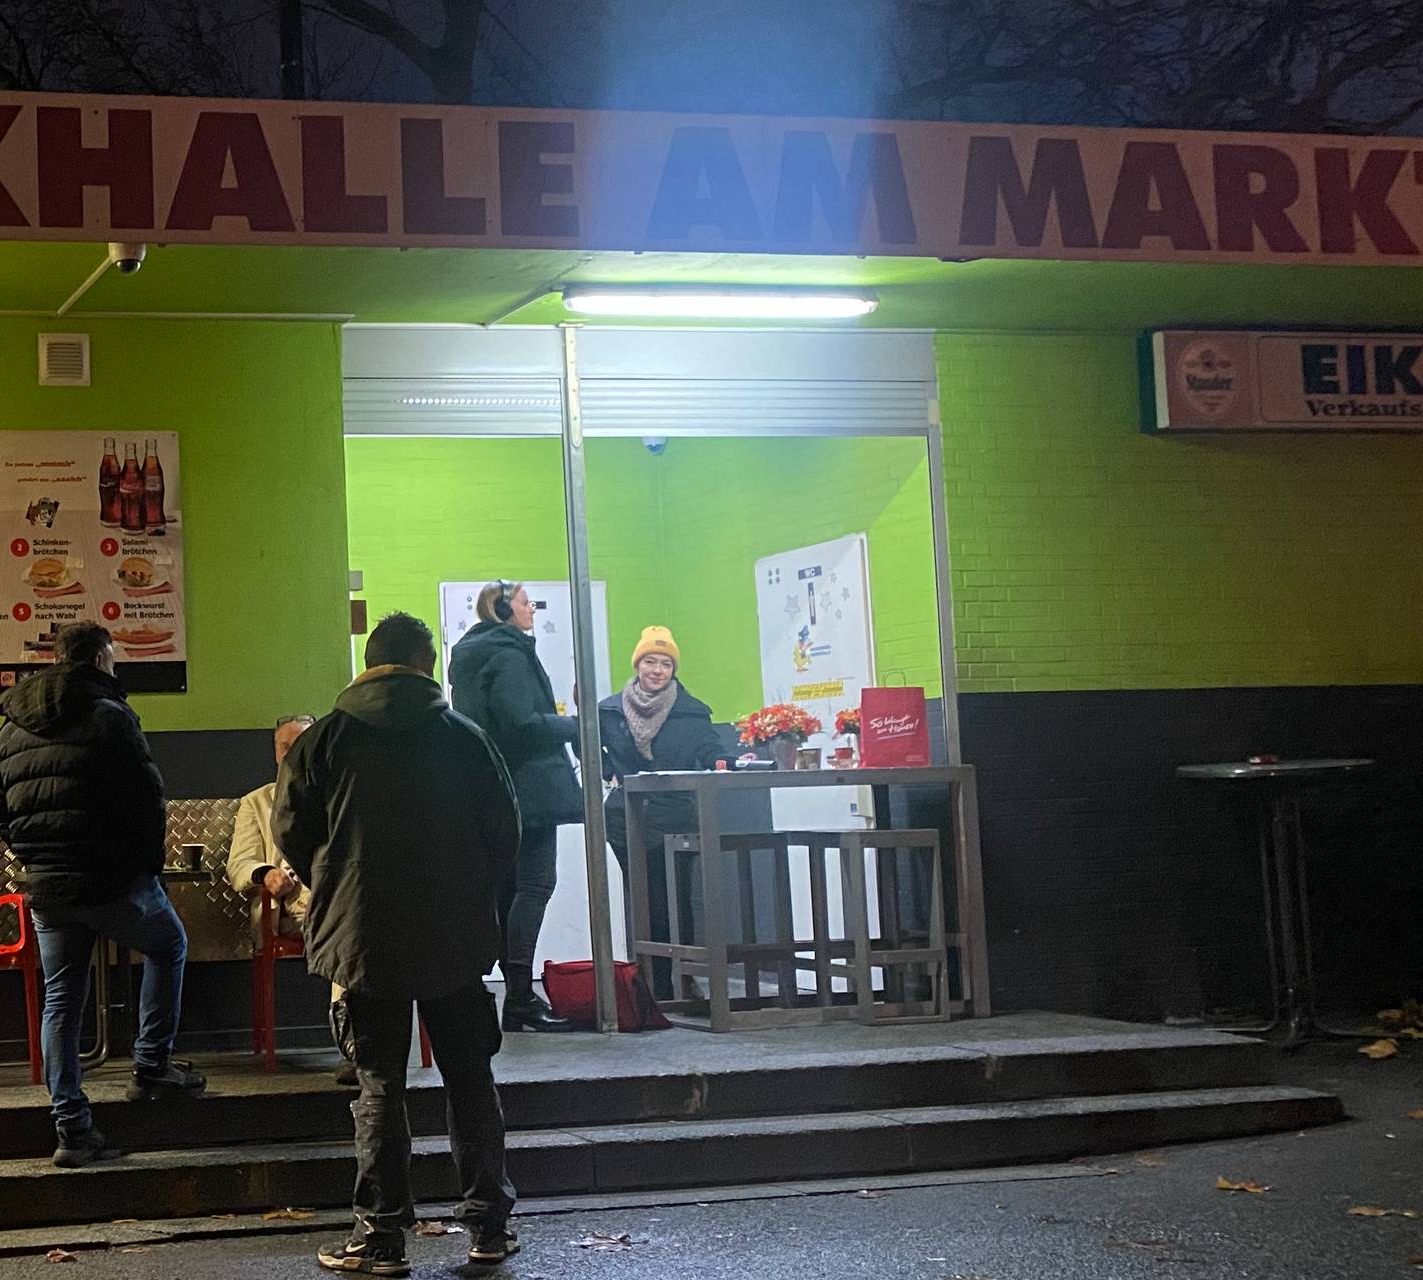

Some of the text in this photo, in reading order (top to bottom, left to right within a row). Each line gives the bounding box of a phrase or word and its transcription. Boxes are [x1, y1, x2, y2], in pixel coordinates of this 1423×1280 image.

[645, 126, 917, 246] AM
[959, 136, 1423, 257] MARK
[1302, 345, 1423, 394] EIK
[1304, 400, 1423, 417] Verkaufs
[17, 543, 23, 551] 2
[33, 548, 68, 556] brötchen
[804, 567, 816, 578] WC
[34, 602, 85, 611] Schokoriegel
[124, 602, 165, 610] Bockwurst
[35, 611, 76, 620] nach Wahl
[124, 611, 175, 620] mit Brötchen
